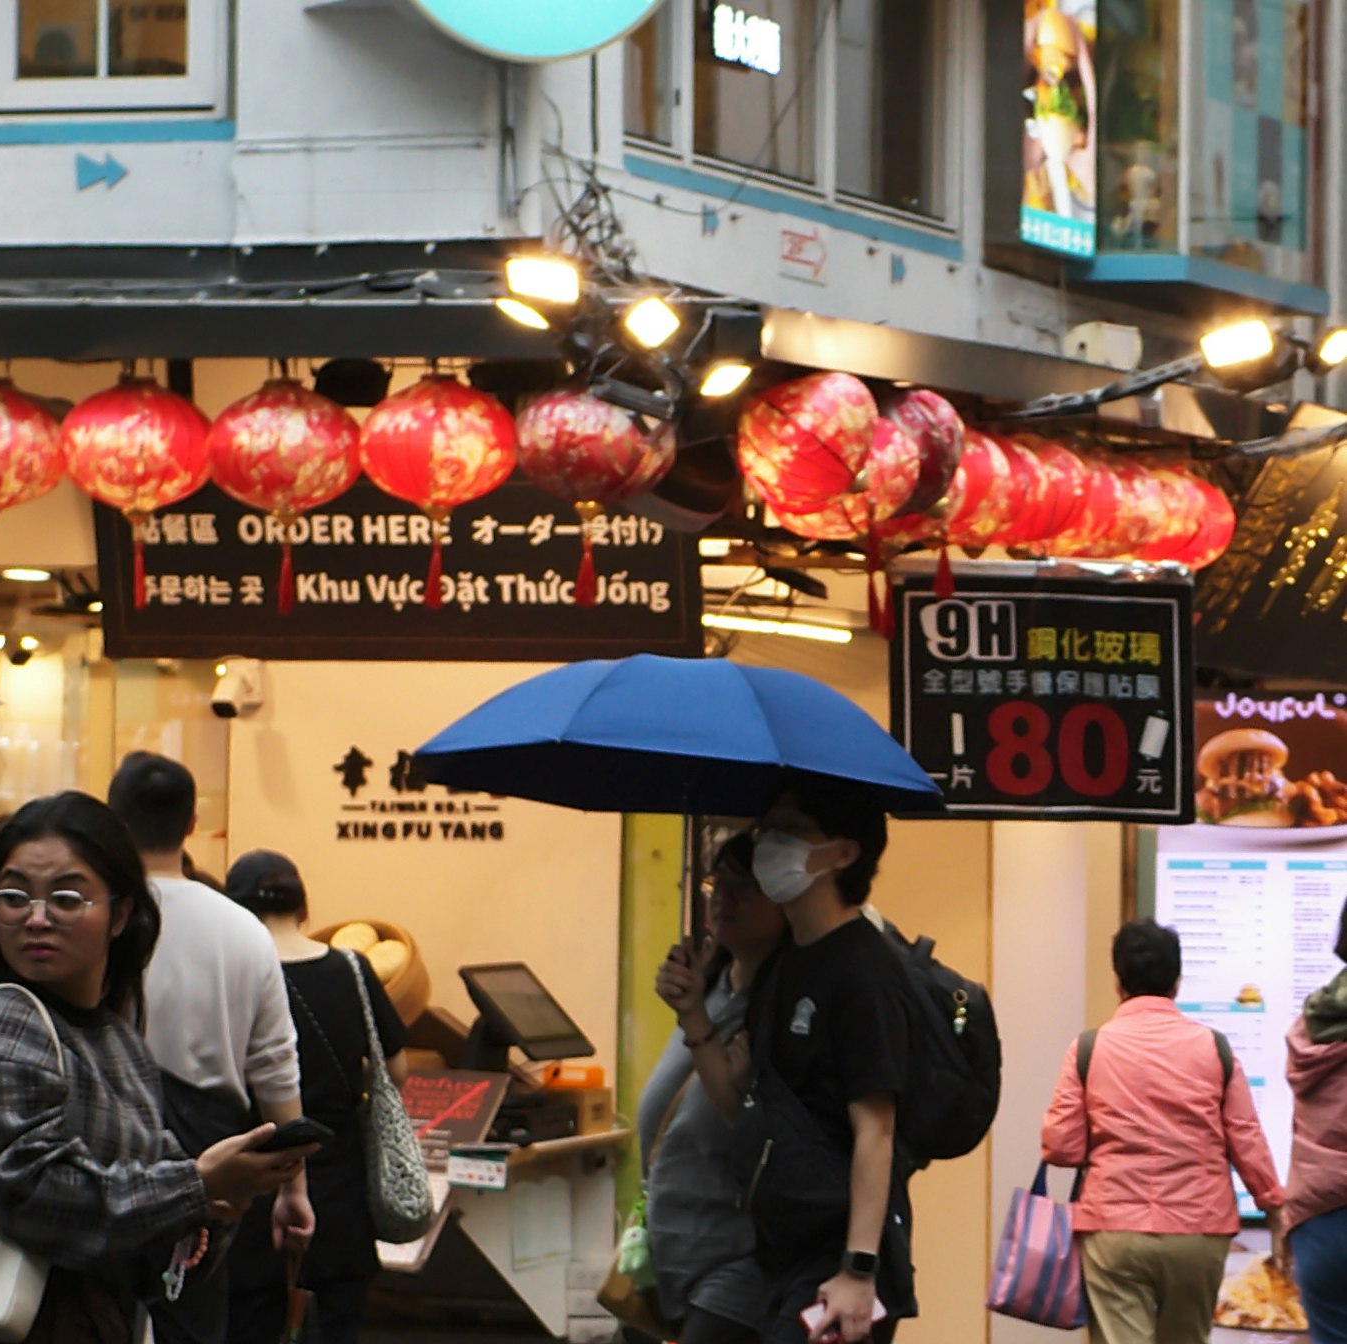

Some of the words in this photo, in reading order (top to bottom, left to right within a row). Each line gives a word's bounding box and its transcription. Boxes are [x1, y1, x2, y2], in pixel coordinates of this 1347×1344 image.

[362, 514, 453, 545] HERE
[296, 572, 360, 603] Khu
[920, 599, 1016, 661] 9H
[985, 700, 1130, 797] 80
[1136, 768, 1163, 794] 元
